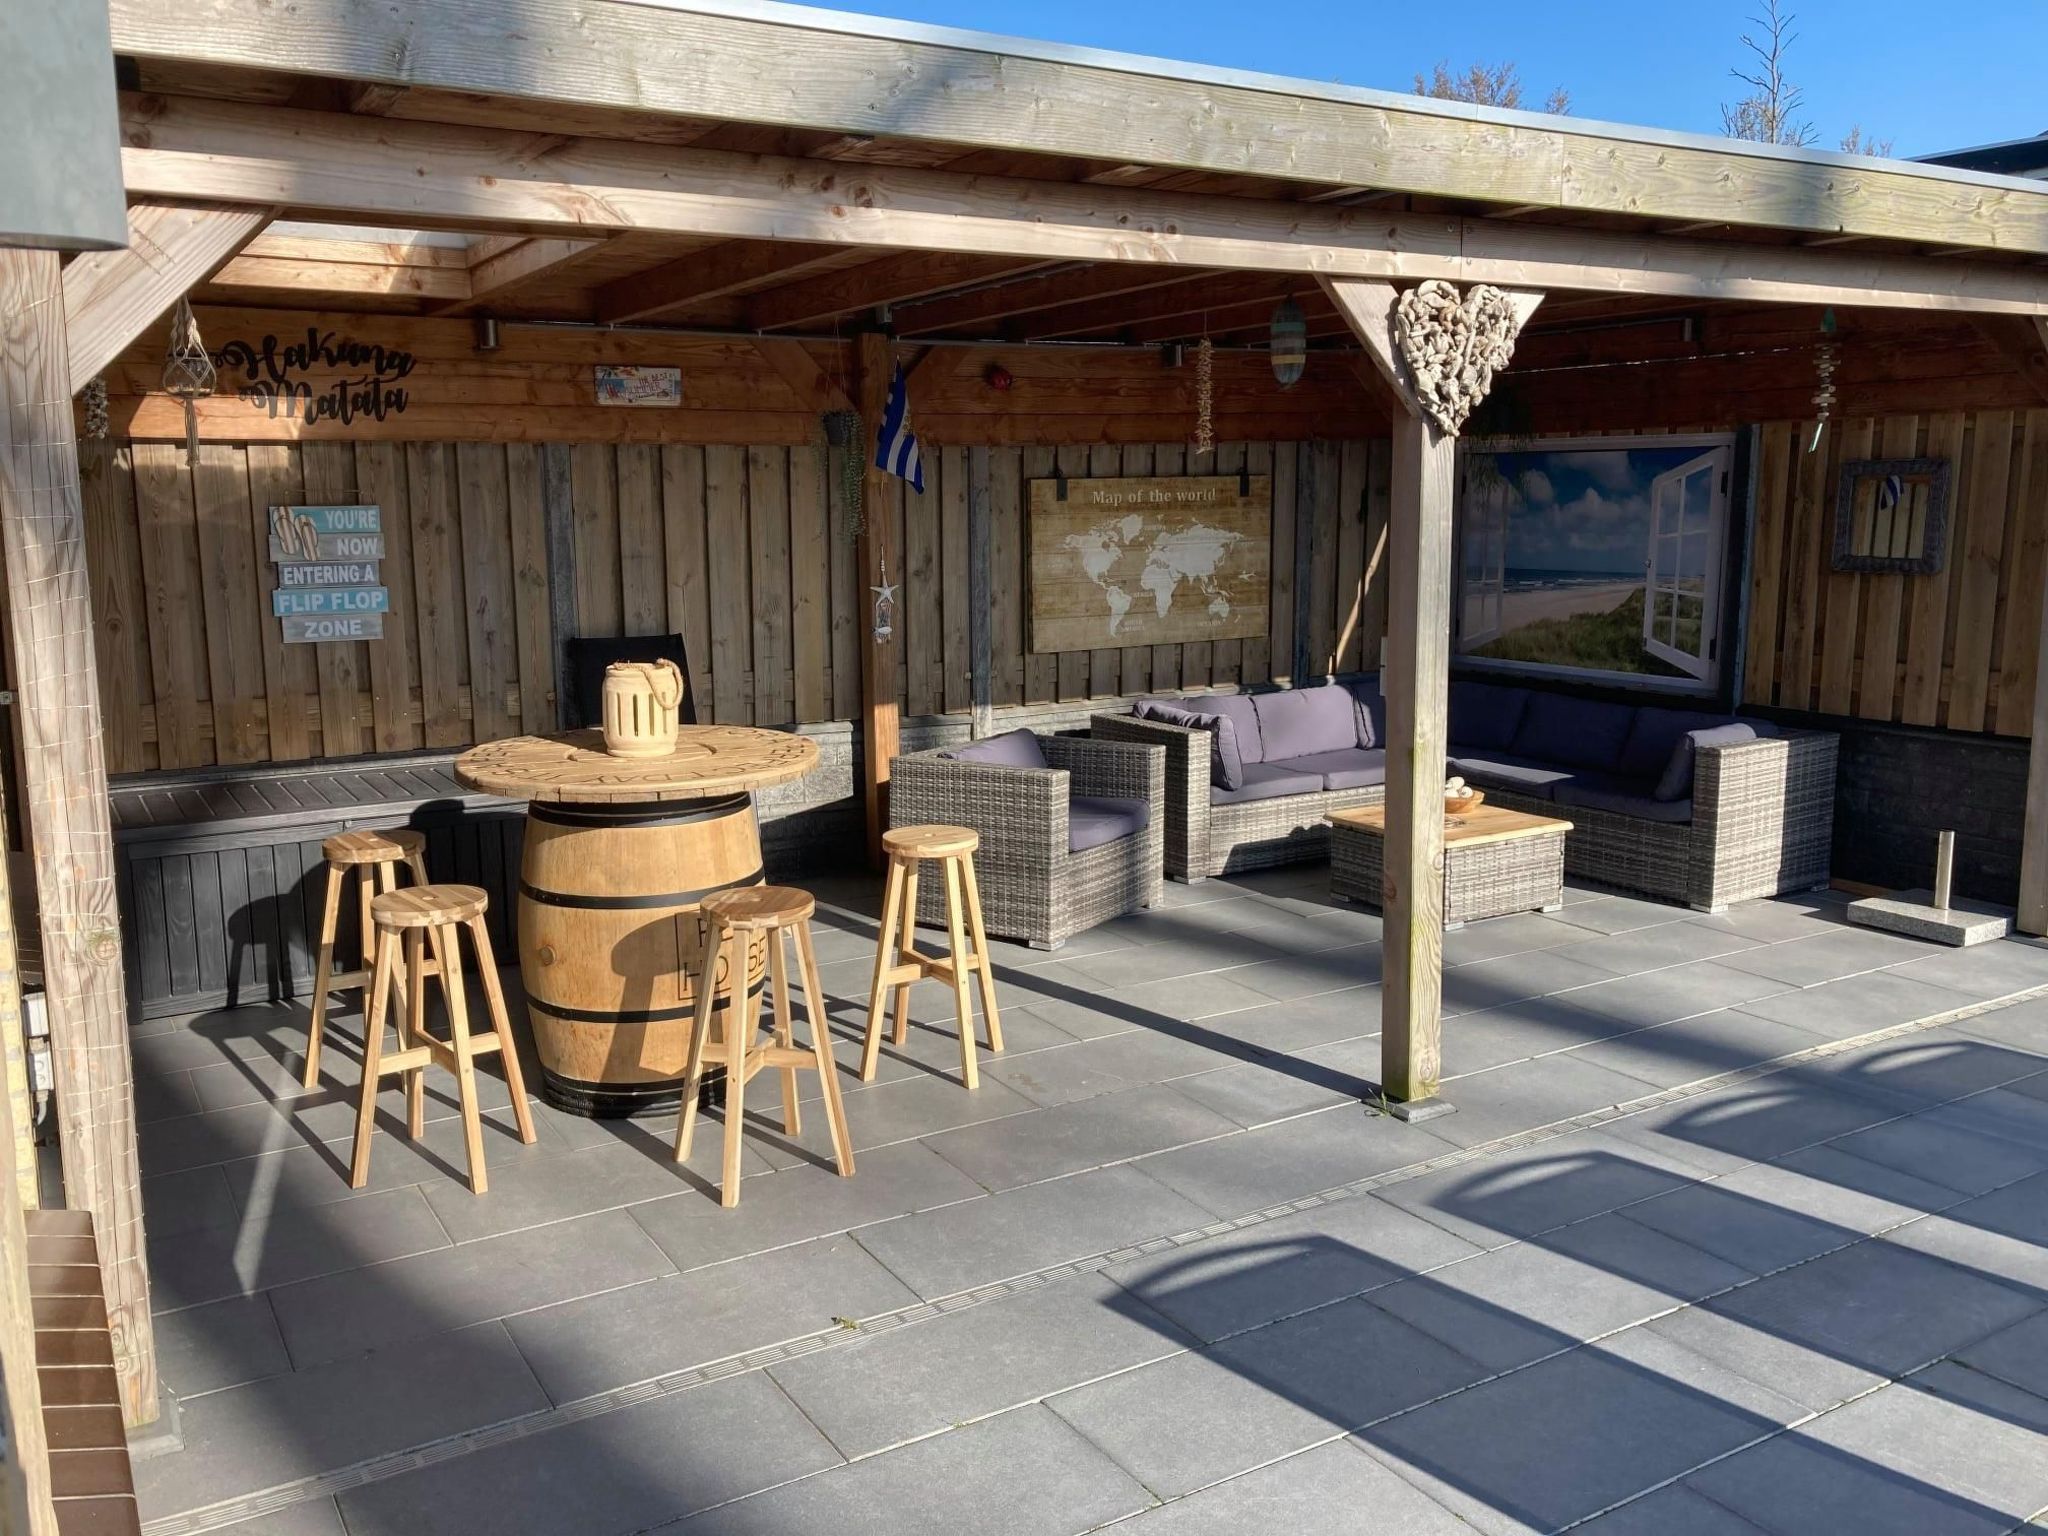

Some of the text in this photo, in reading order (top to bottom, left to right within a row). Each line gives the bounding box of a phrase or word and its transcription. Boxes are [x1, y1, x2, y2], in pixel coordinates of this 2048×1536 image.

[214, 328, 417, 383] Hakuna
[239, 375, 409, 425] Matata
[1092, 487, 1216, 507] Map of the world
[325, 510, 376, 529] YOU'RE
[337, 537, 377, 556] NOW
[283, 564, 375, 585] ENTERING A
[278, 591, 384, 613] FLIP FLOP
[304, 619, 363, 638] ZONE
[582, 773, 672, 784] DAY
[682, 936, 767, 992] HOSE
